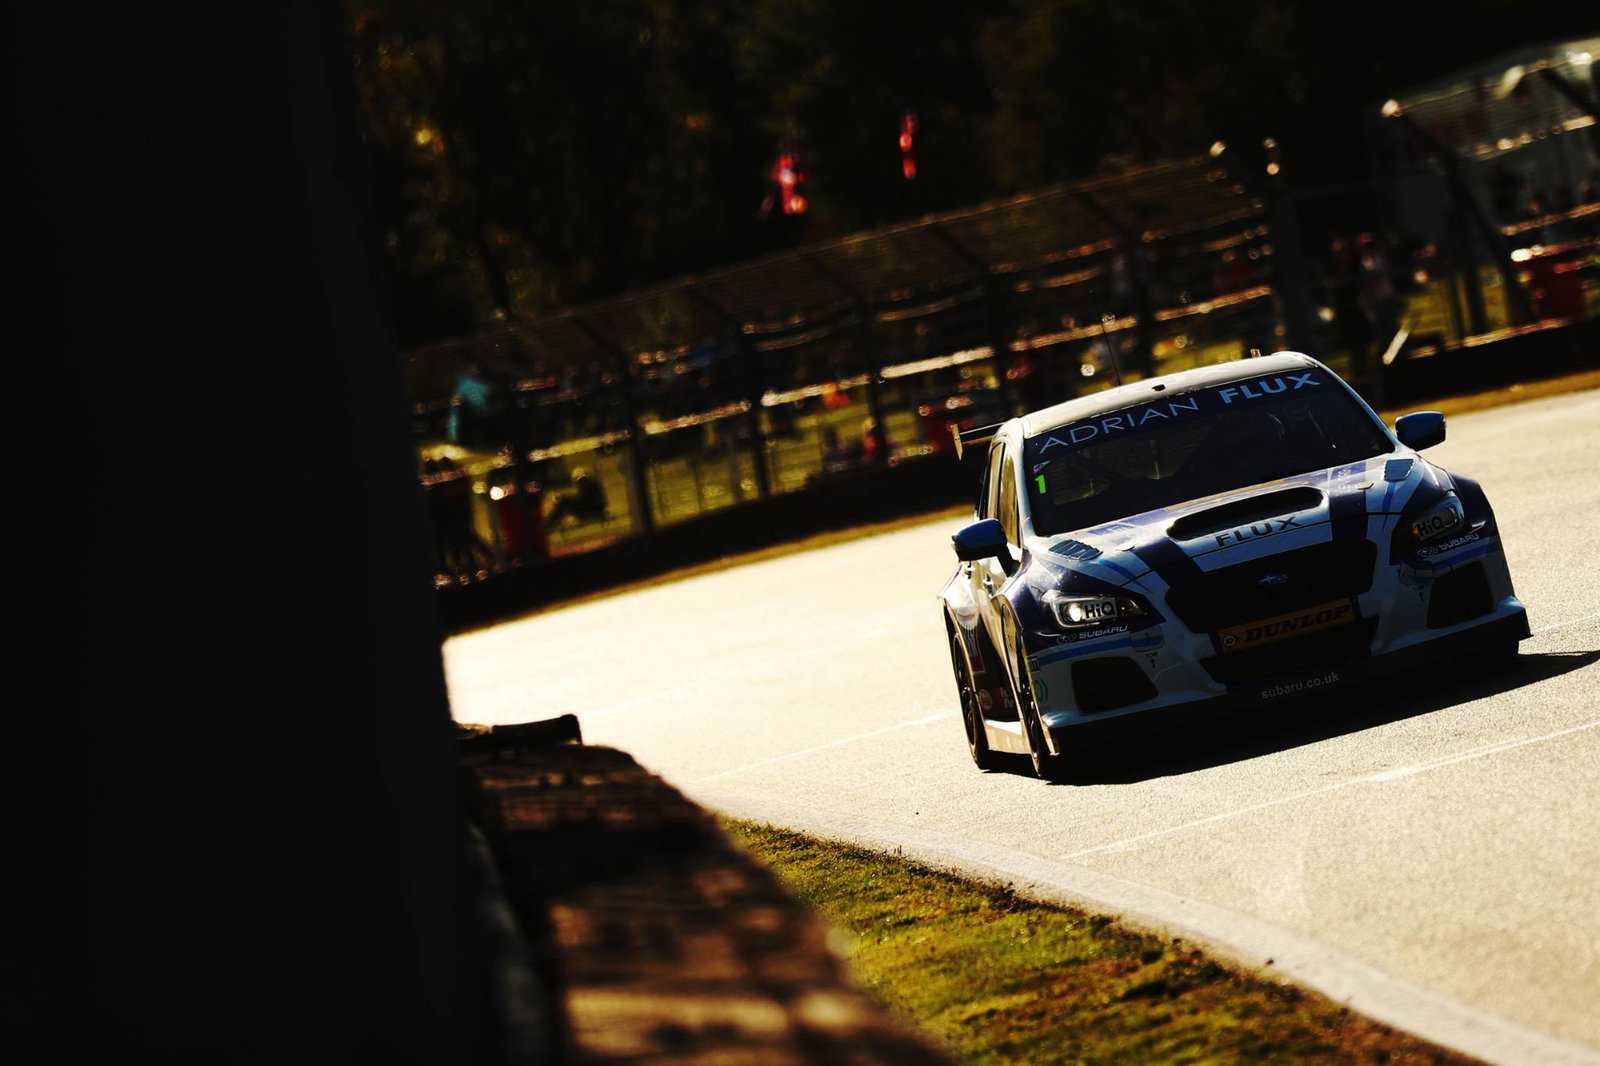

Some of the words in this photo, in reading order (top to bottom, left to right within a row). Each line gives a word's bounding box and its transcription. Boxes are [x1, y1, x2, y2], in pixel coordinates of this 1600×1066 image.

[1039, 397, 1200, 454] ADRIAN
[1218, 373, 1321, 404] FLUX
[1034, 474, 1047, 494] 1
[1215, 516, 1300, 547] FLUX
[1420, 516, 1443, 537] HiQ
[1438, 533, 1480, 550] SUBARU
[1084, 600, 1116, 619] HiQ
[1078, 624, 1129, 640] SUBARU
[1244, 605, 1351, 643] DUNLOP
[1260, 672, 1341, 700] subaru.co.uk
